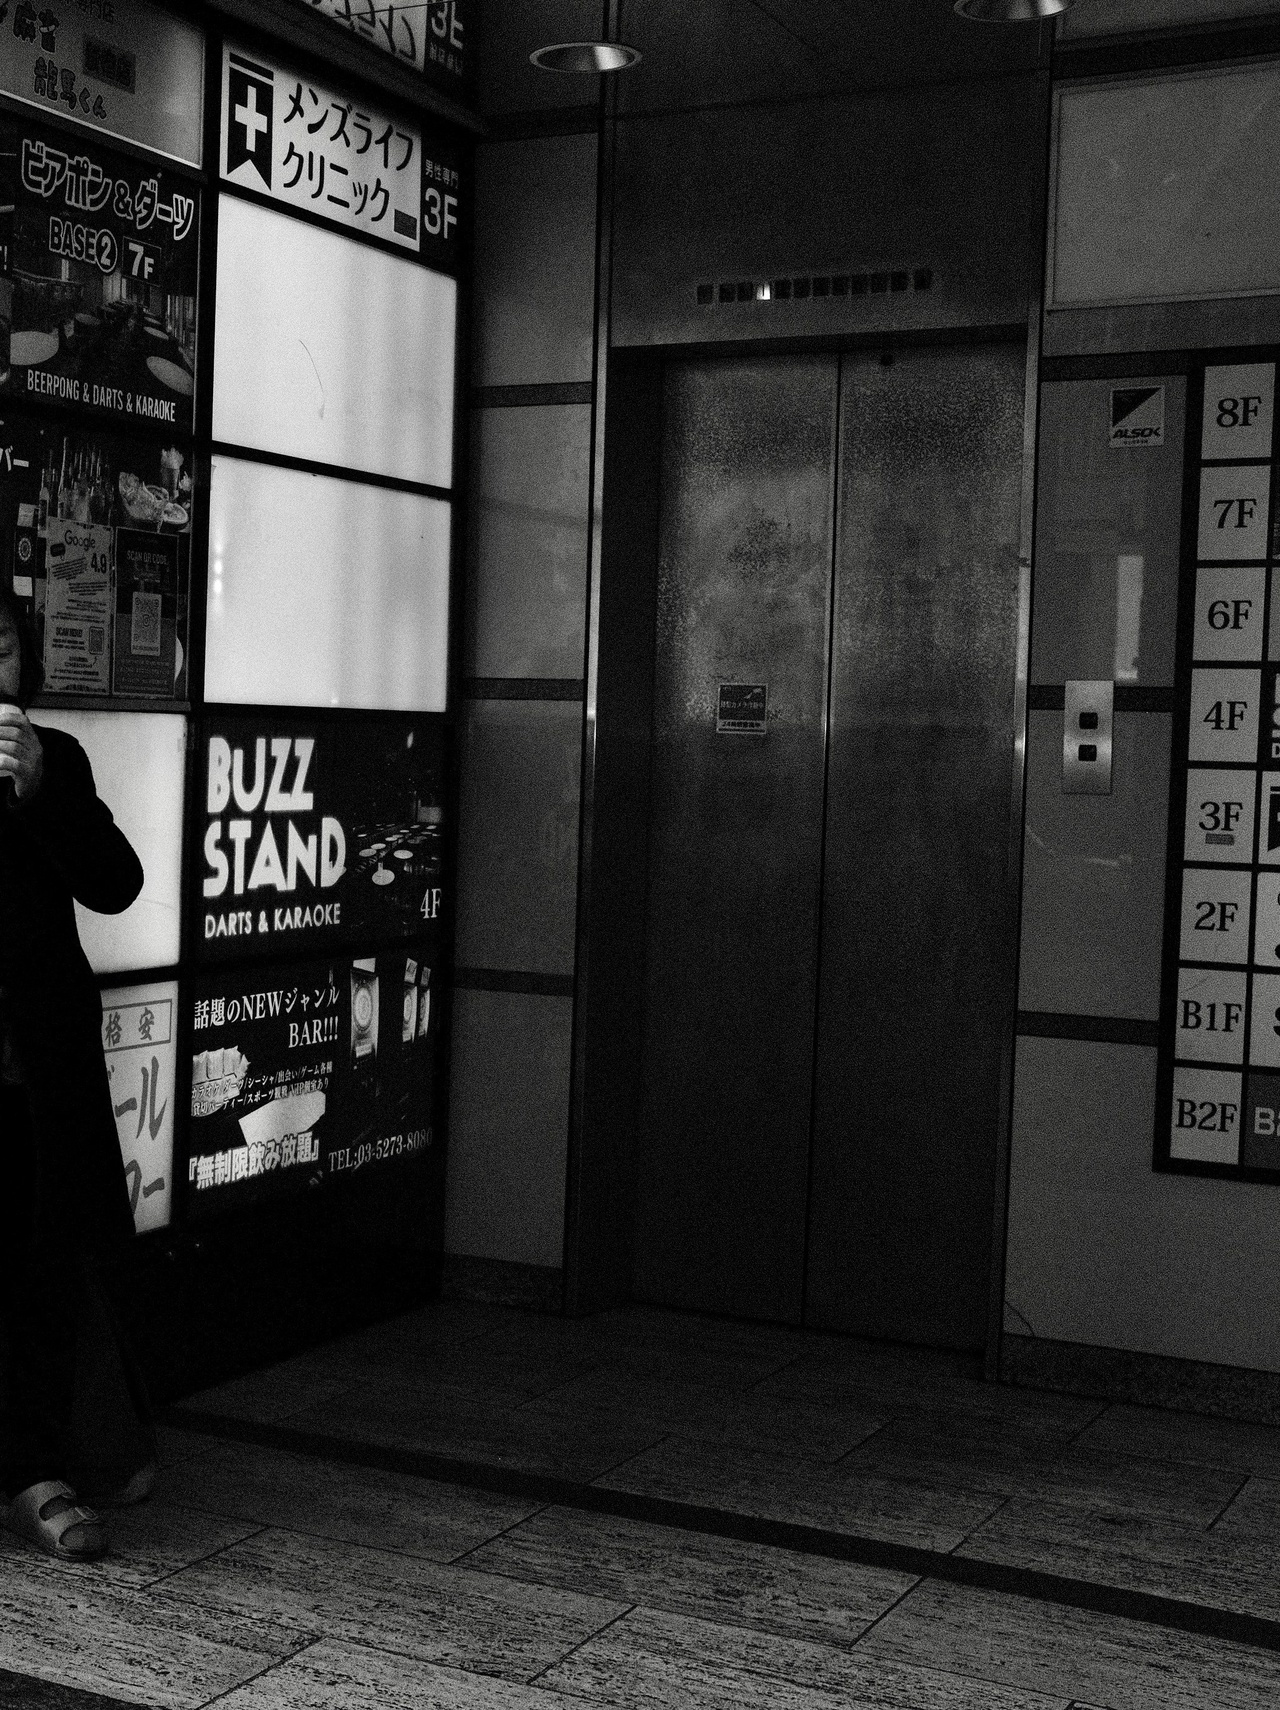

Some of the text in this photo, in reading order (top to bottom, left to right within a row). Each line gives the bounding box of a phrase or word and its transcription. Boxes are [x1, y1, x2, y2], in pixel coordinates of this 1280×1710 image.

[283, 82, 415, 171] メンズライフ
[283, 141, 390, 222] クリニック
[423, 186, 459, 240] 3F
[127, 242, 156, 279] 7F
[27, 368, 177, 423] BEERPONG & DARTS & KARAOKE
[1216, 395, 1263, 428] 8F
[1112, 426, 1162, 439] ALSOK
[1213, 498, 1258, 529] 7F
[64, 529, 96, 551] Google
[90, 552, 108, 575] 4.9
[1207, 599, 1253, 630] 6F
[1202, 700, 1249, 731] 4F
[207, 736, 316, 814] BUZZ
[1198, 801, 1244, 832] 3F
[202, 815, 347, 899] STAND
[420, 887, 442, 919] 4F
[1194, 901, 1239, 932] 2F
[204, 902, 342, 939] DARTS & KARAOKE
[193, 985, 341, 1031] 話題のNEWジャンル
[1180, 999, 1243, 1033] B1F
[288, 1015, 339, 1049] BAR!!!
[1175, 1098, 1238, 1134] B2F
